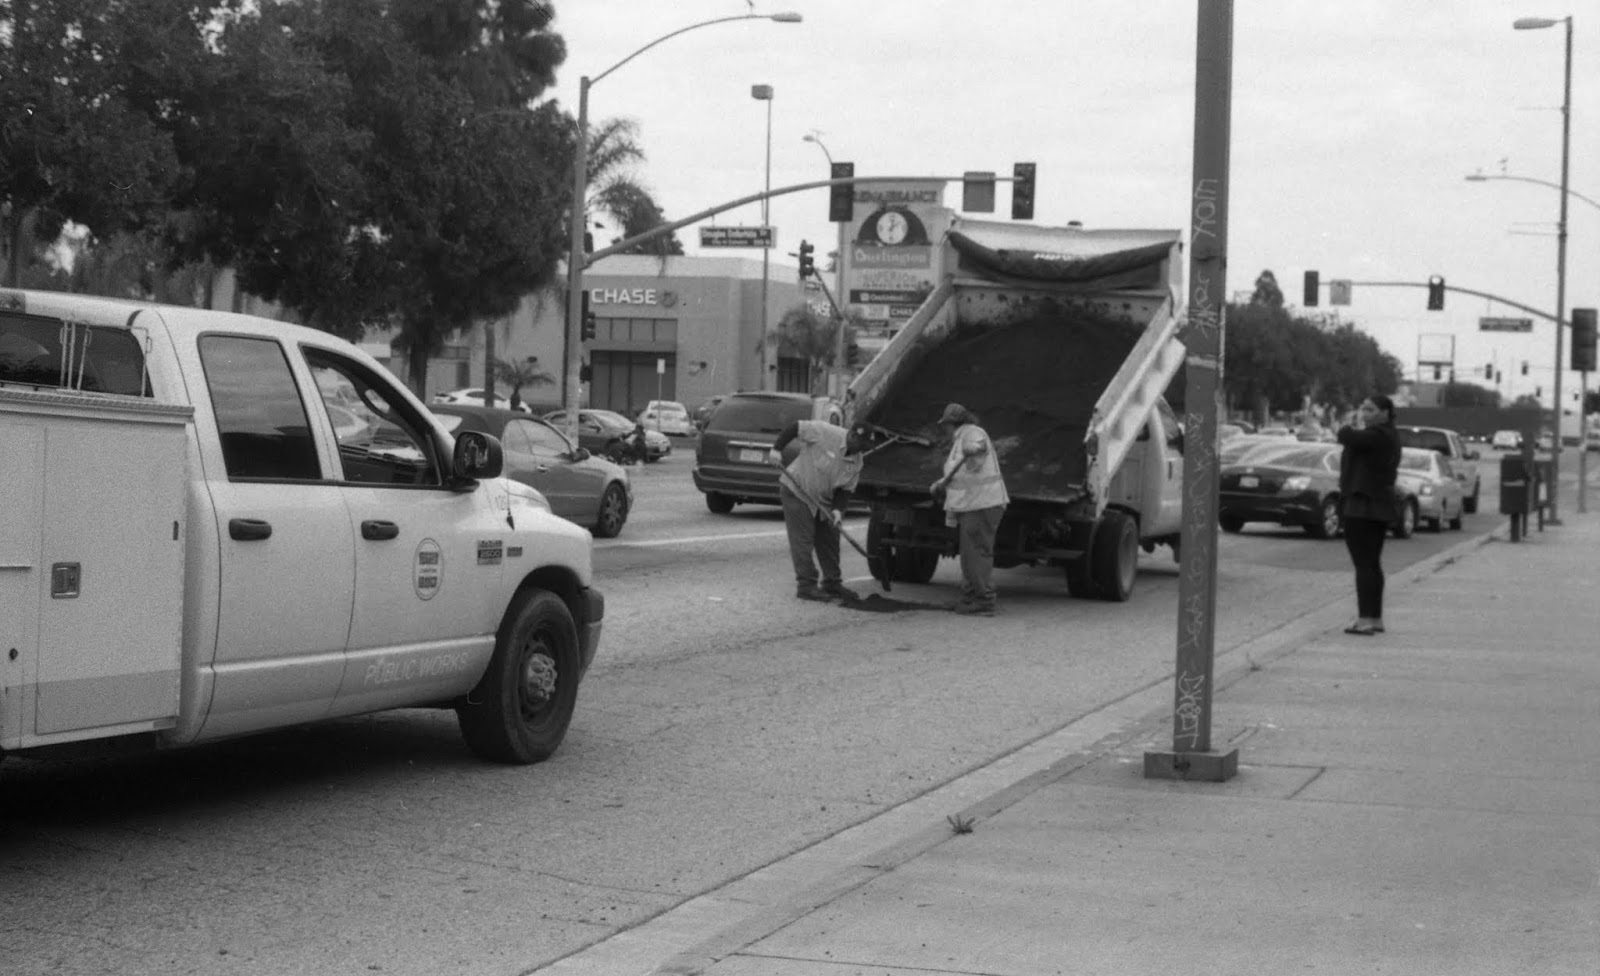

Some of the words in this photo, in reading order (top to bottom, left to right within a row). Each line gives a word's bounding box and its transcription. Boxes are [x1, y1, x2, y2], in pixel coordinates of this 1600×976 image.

[591, 288, 657, 304] CHASE
[363, 659, 416, 686] PUBLIC
[418, 652, 469, 678] WORKS
